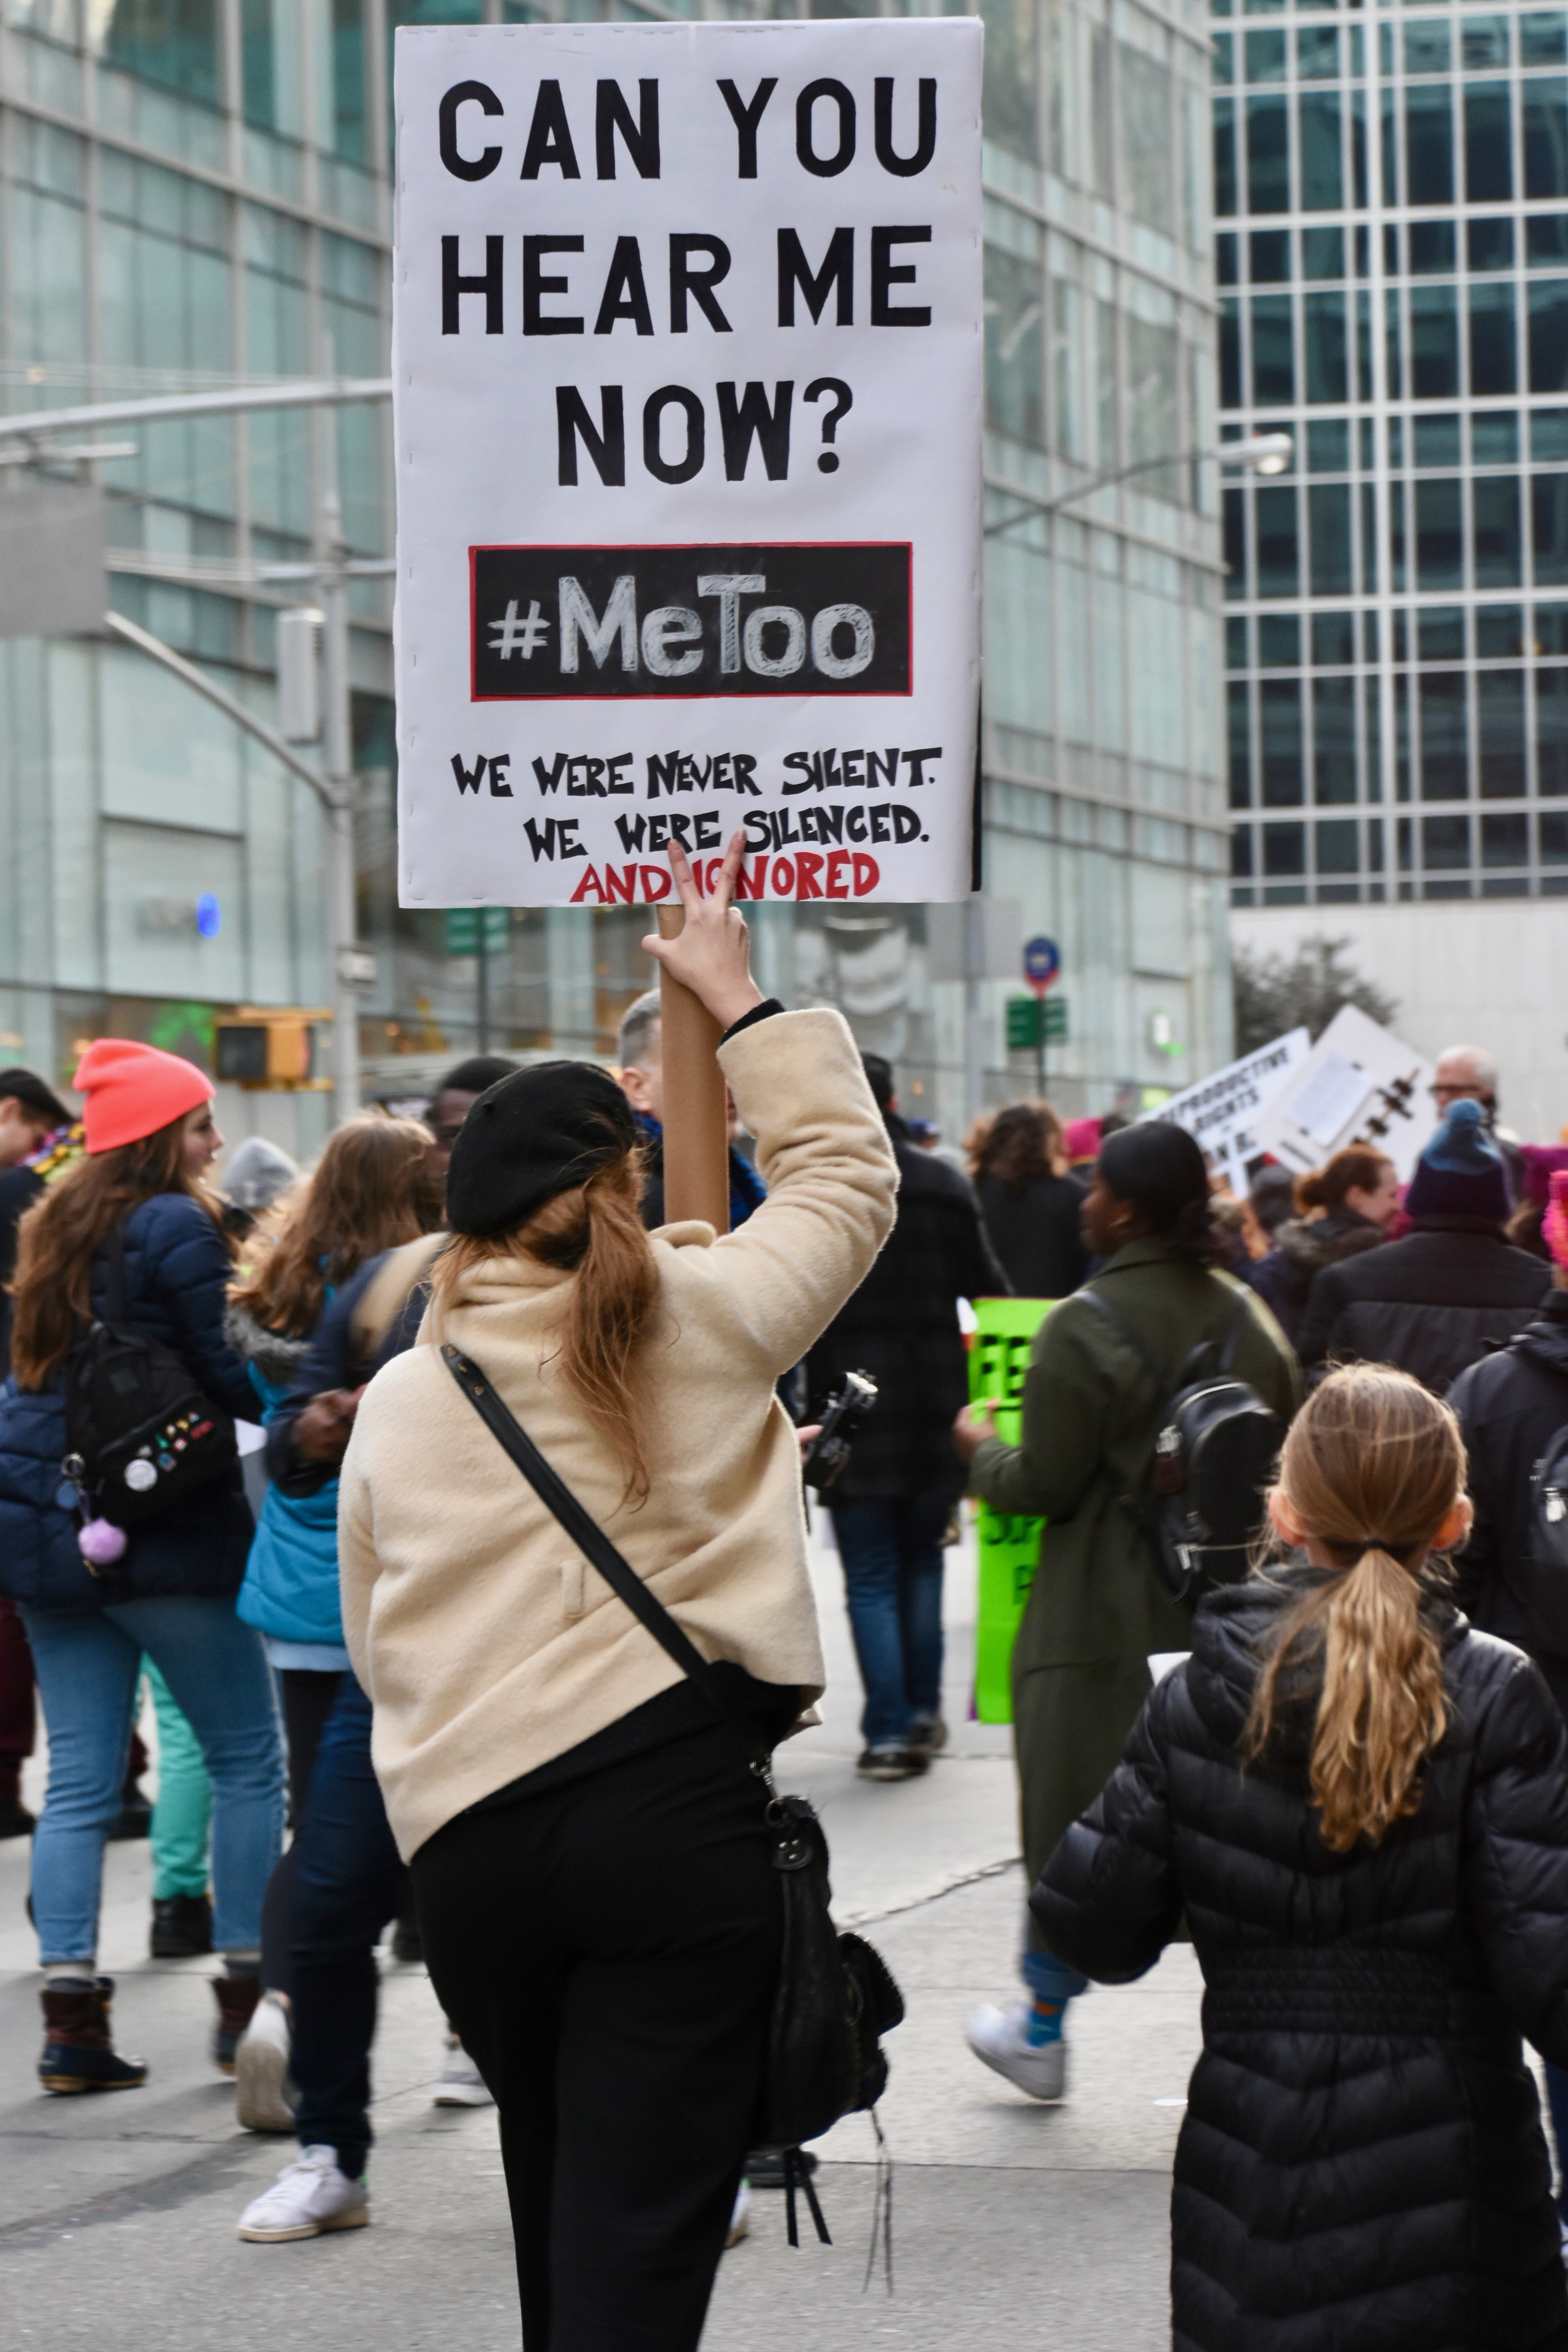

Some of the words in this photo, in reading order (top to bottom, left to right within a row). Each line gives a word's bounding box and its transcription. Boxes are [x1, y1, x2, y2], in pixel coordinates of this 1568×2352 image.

[439, 79, 660, 181] CAN
[716, 77, 937, 178] YOU
[441, 233, 733, 336] HEAR
[777, 225, 932, 327] ME
[556, 377, 852, 486] NOW?
[488, 574, 875, 679] #MeToo
[451, 753, 514, 797] WE
[532, 753, 634, 797] WERE
[647, 750, 762, 799] NEVER
[782, 747, 942, 795] SILENT.
[523, 818, 588, 862] WE
[614, 810, 722, 855] WERE
[743, 803, 929, 854] SILENCED.
[570, 862, 671, 904] AND
